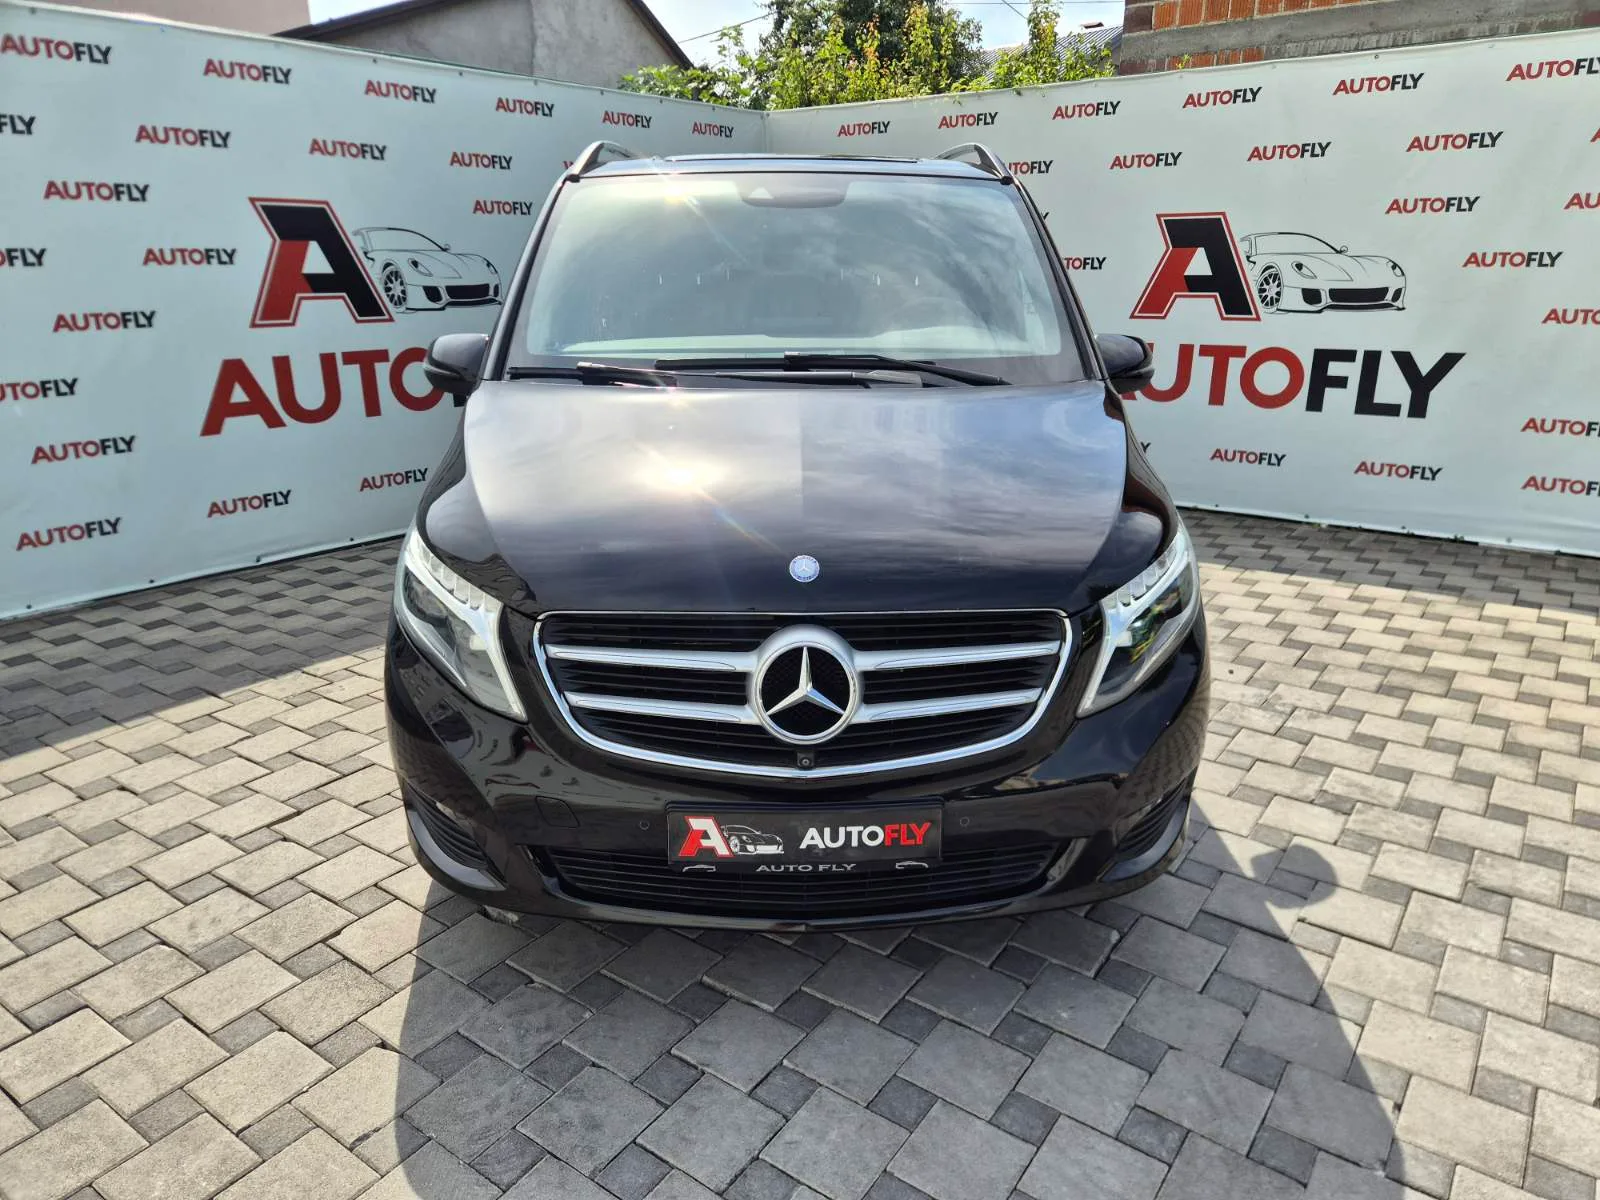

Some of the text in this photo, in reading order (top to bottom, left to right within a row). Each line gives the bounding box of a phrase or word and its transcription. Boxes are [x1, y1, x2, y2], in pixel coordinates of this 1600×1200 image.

[1, 34, 112, 64] AUTOFLY
[203, 59, 292, 85] AUTOFLY
[365, 80, 436, 104] AUTOFLY
[1332, 73, 1424, 95] AUTOFLY
[496, 97, 554, 117] AUTOFLY
[1182, 87, 1262, 109] AUTOFLY
[603, 111, 652, 128] AUTOFLY
[938, 112, 998, 129] AUTOFLY
[1052, 101, 1121, 120] AUTOFLY
[135, 125, 231, 148] AUTOFLY
[692, 122, 734, 138] AUTOFLY
[837, 121, 890, 137] AUTOFLY
[309, 139, 387, 160] AUTOFLY
[1247, 142, 1332, 161] AUTOFLY
[1406, 131, 1503, 152] AUTOFLY
[450, 152, 512, 170] AUTOFLY
[1009, 160, 1053, 175] TOFLY
[1110, 152, 1182, 170] AUTOFLY
[44, 181, 149, 202] AUTOFLY
[473, 200, 533, 215] AUTOFLY
[1385, 196, 1480, 214] AUTOFLY
[143, 248, 236, 266] AUTOFLY
[1064, 257, 1107, 270] TOFLY
[1462, 252, 1563, 267] AUTOFLY
[53, 310, 156, 333] AUTOFLY
[1120, 343, 1467, 419] UTOFLY
[200, 347, 464, 437] AUTO
[1521, 418, 1600, 437] AUTOF
[31, 435, 136, 464] AUTOFLY
[1210, 448, 1286, 467] AUTOFLY
[360, 468, 429, 492] AUTOFLY
[1354, 461, 1443, 481] AUTOFLY
[1521, 476, 1600, 497] AUTOF
[208, 490, 291, 518] AUTOFLY
[16, 517, 121, 551] AUTOFLY
[800, 822, 931, 849] AUTOFLY
[818, 864, 857, 872] FLY
